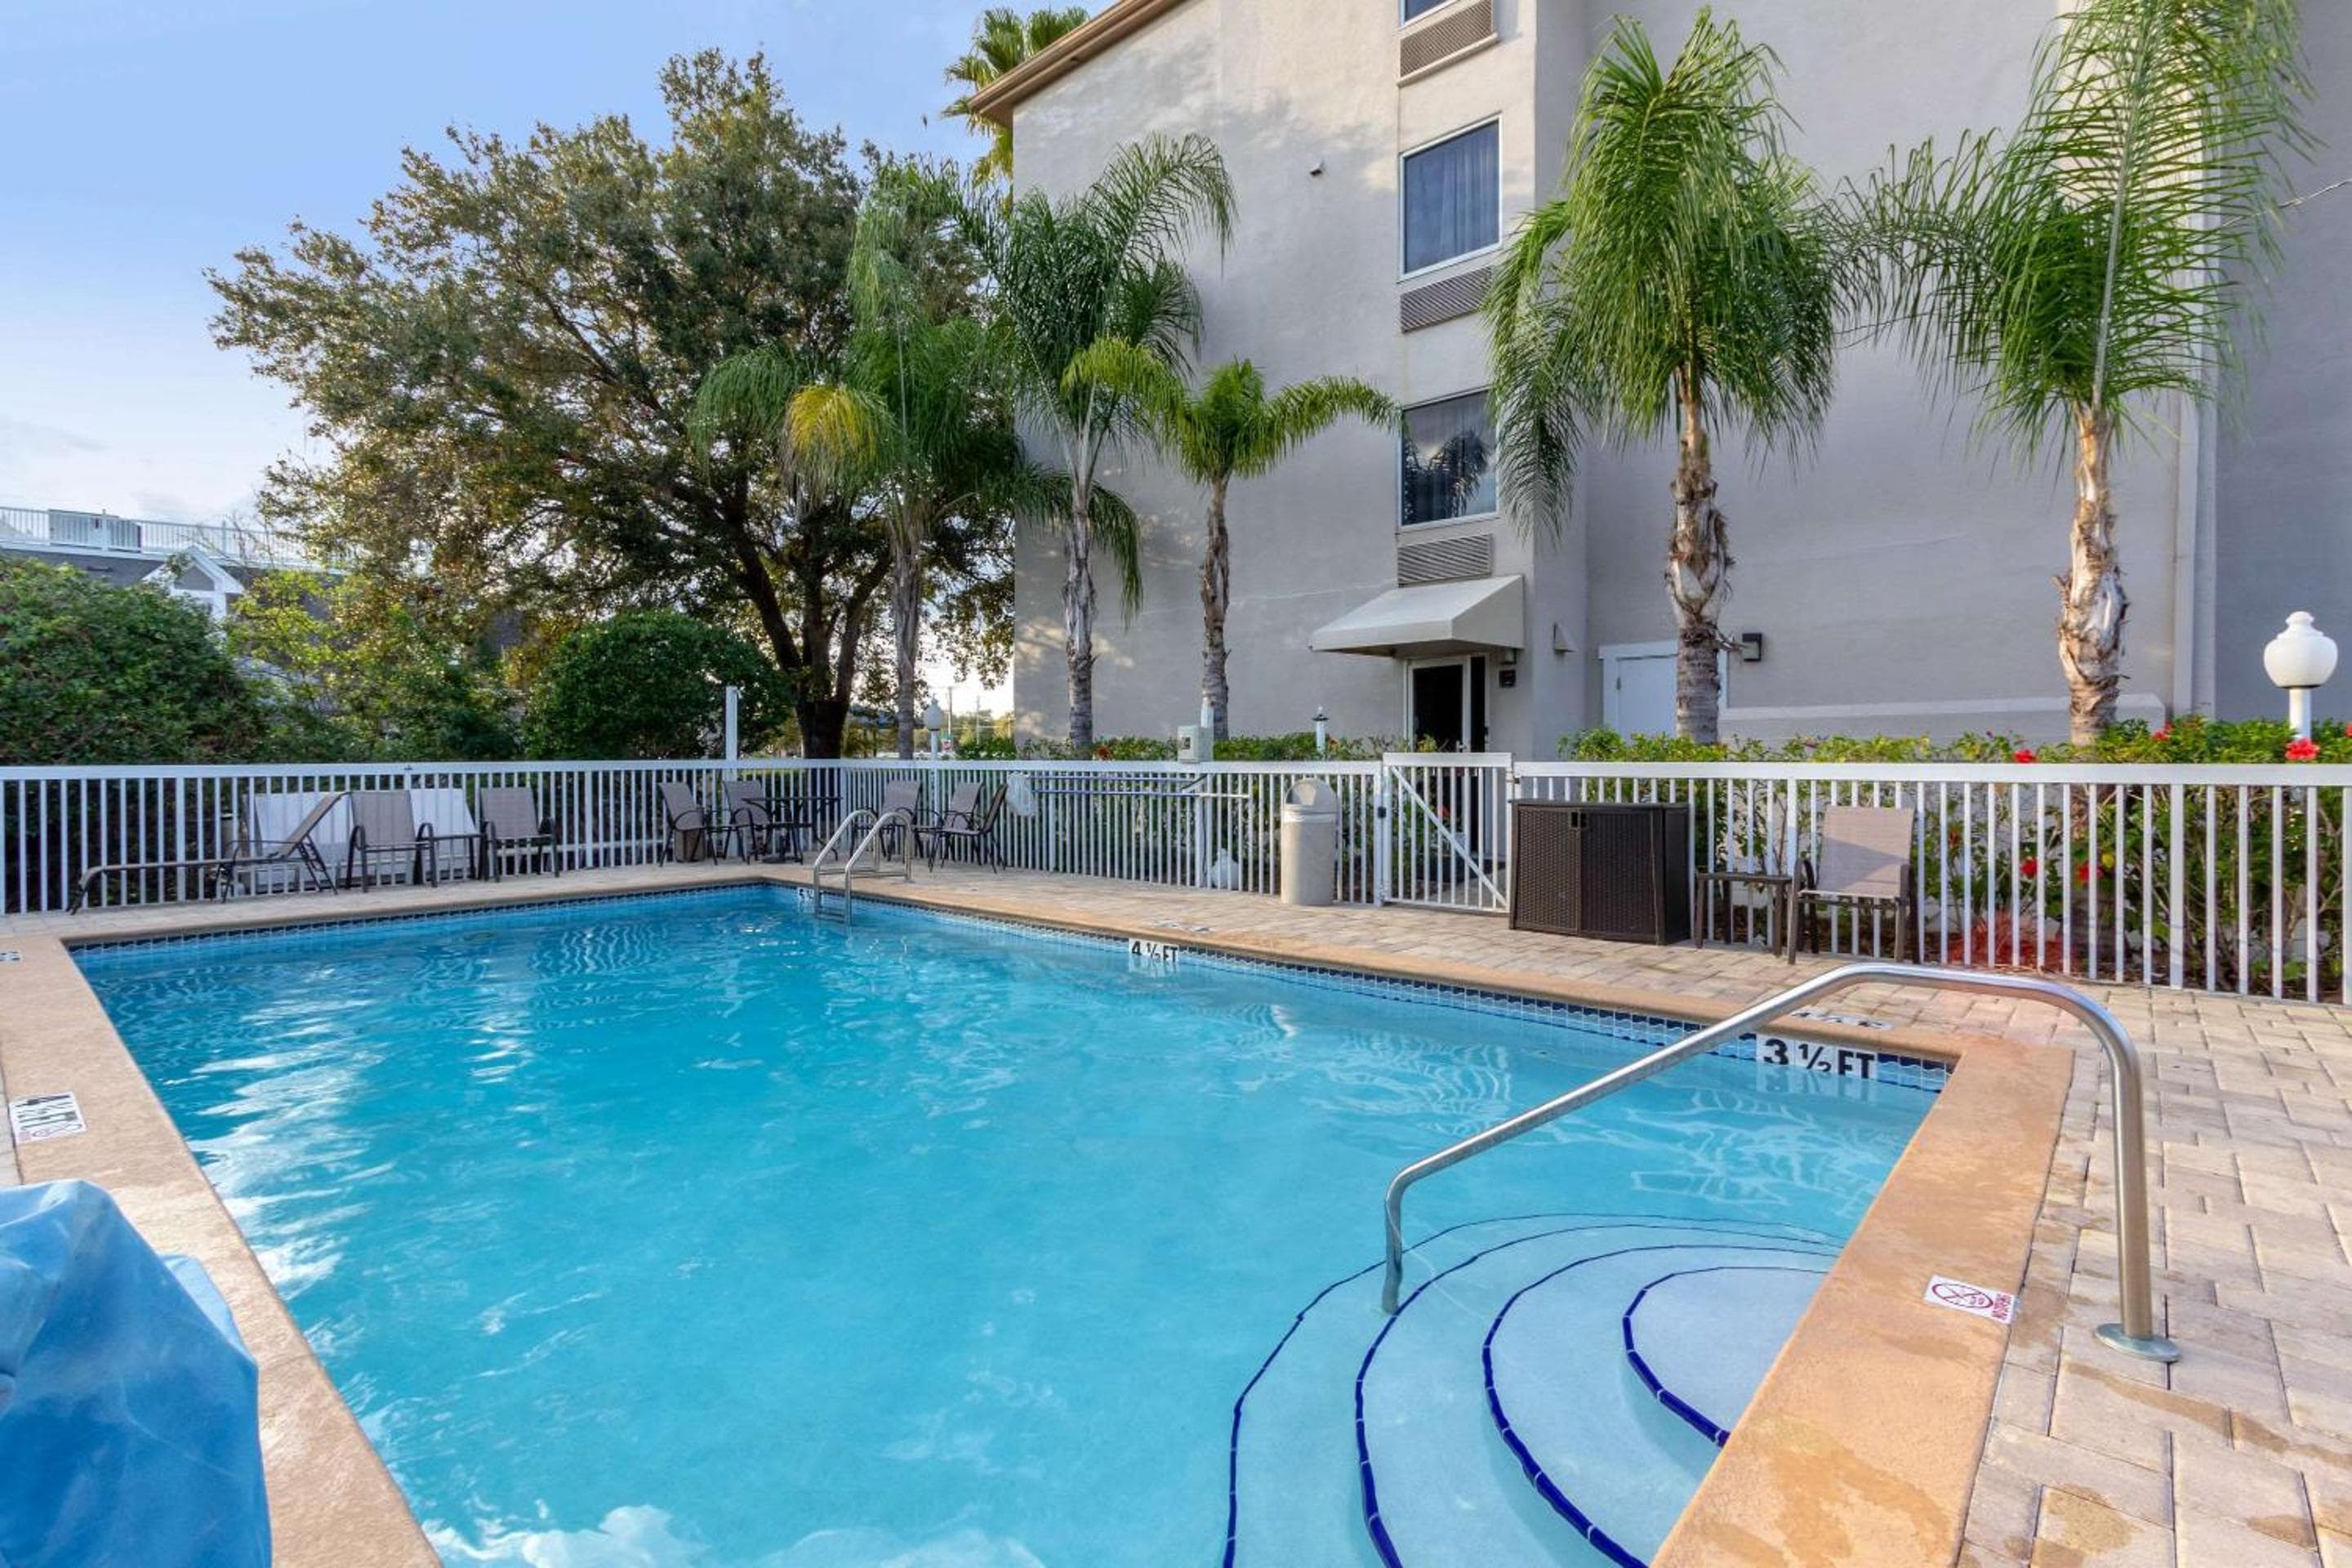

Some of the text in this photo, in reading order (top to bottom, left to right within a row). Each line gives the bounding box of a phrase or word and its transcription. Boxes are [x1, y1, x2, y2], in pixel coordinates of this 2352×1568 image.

[1132, 941, 1142, 956] 4
[1163, 945, 1178, 962] FT
[1763, 1039, 1788, 1065] 3
[1838, 1049, 1875, 1079] FT
